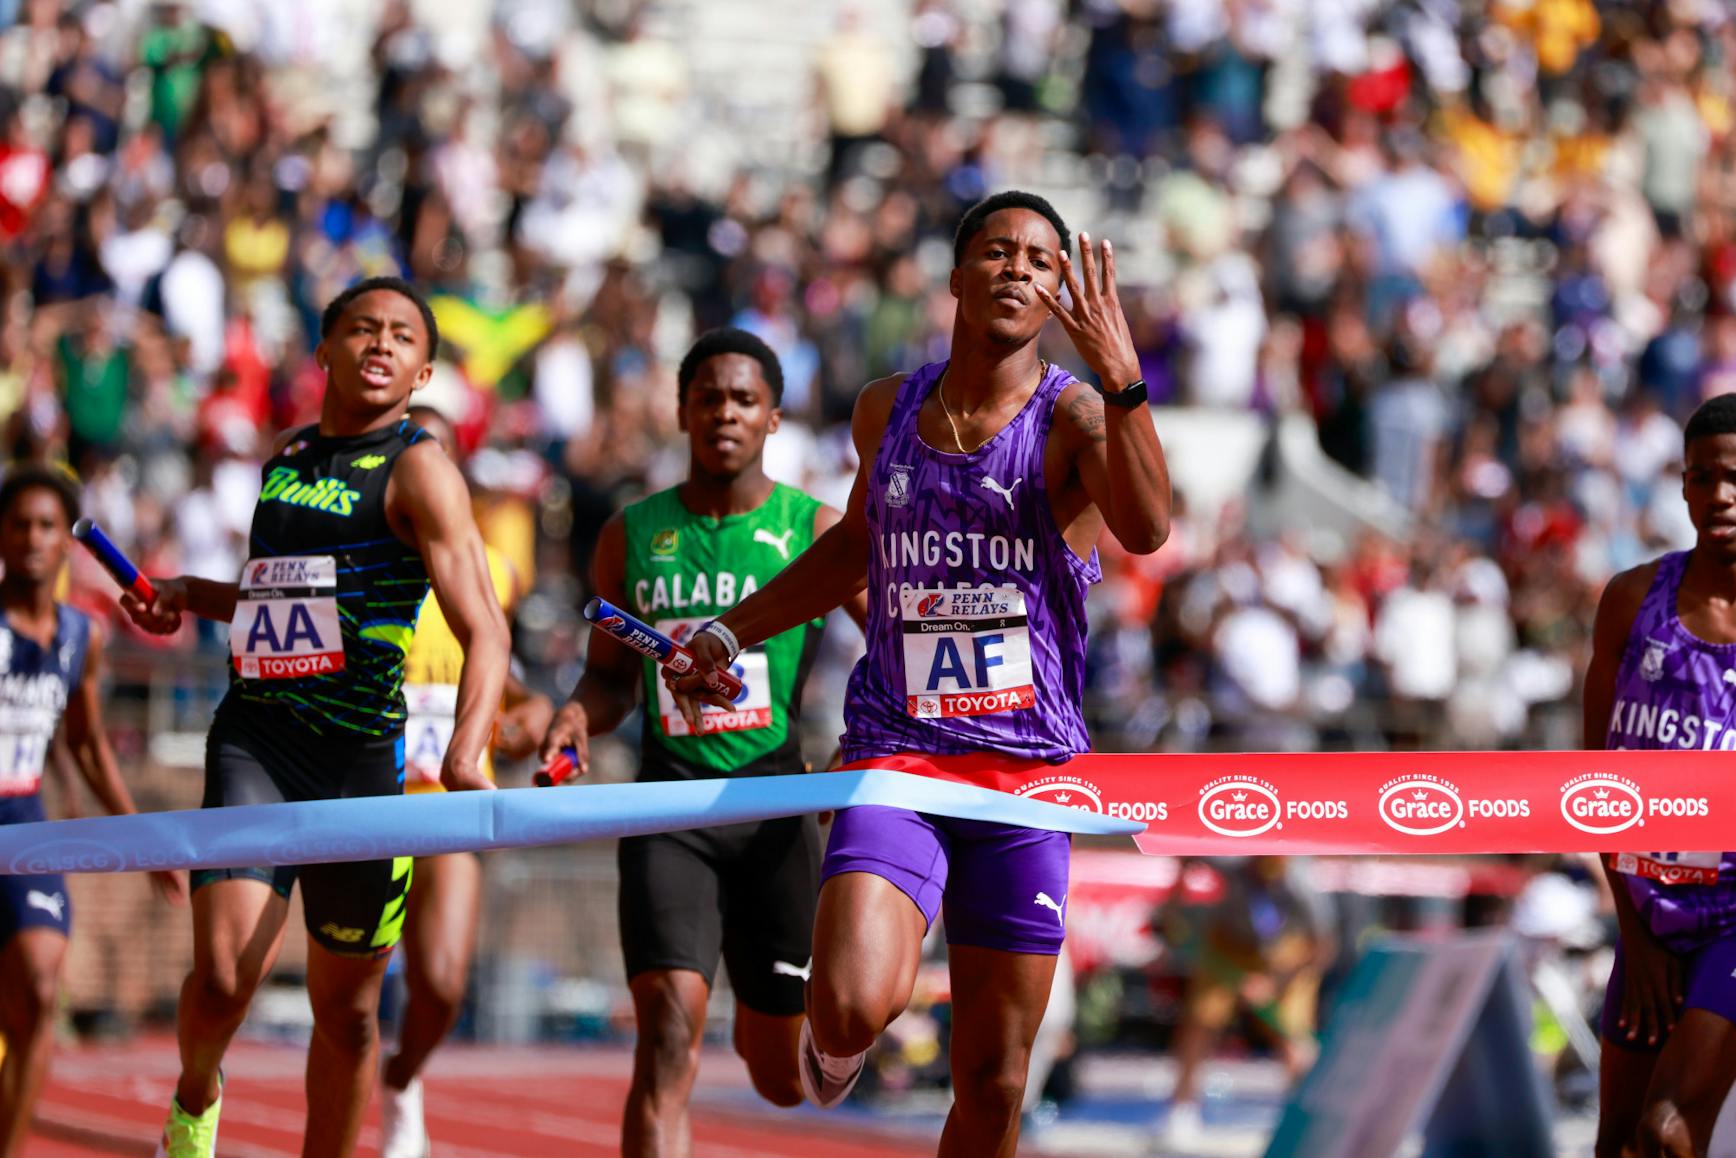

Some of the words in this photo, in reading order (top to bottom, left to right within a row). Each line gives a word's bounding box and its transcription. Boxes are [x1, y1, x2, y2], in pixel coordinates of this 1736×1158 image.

[951, 592, 995, 604] PENN
[951, 603, 1009, 616] RELAYS
[246, 603, 324, 653] AA
[921, 623, 953, 632] Dream
[621, 636, 662, 660] RELAYS
[630, 627, 660, 649] PENN
[262, 656, 333, 675] TOYOTA
[926, 633, 1005, 691] AF
[945, 691, 1022, 713] TOYOTA
[1057, 775, 1082, 785] SINCE
[1233, 775, 1258, 784] SINCE
[1412, 773, 1438, 783] SINCE
[1593, 772, 1619, 782] SINCE
[1108, 801, 1169, 821] FOODS
[1209, 799, 1269, 820] Grace
[1286, 800, 1348, 820] FOODS
[1390, 798, 1452, 819] Grace
[1468, 799, 1531, 818] FOODS
[1572, 796, 1632, 818] Grace
[1648, 797, 1709, 817] FOODS
